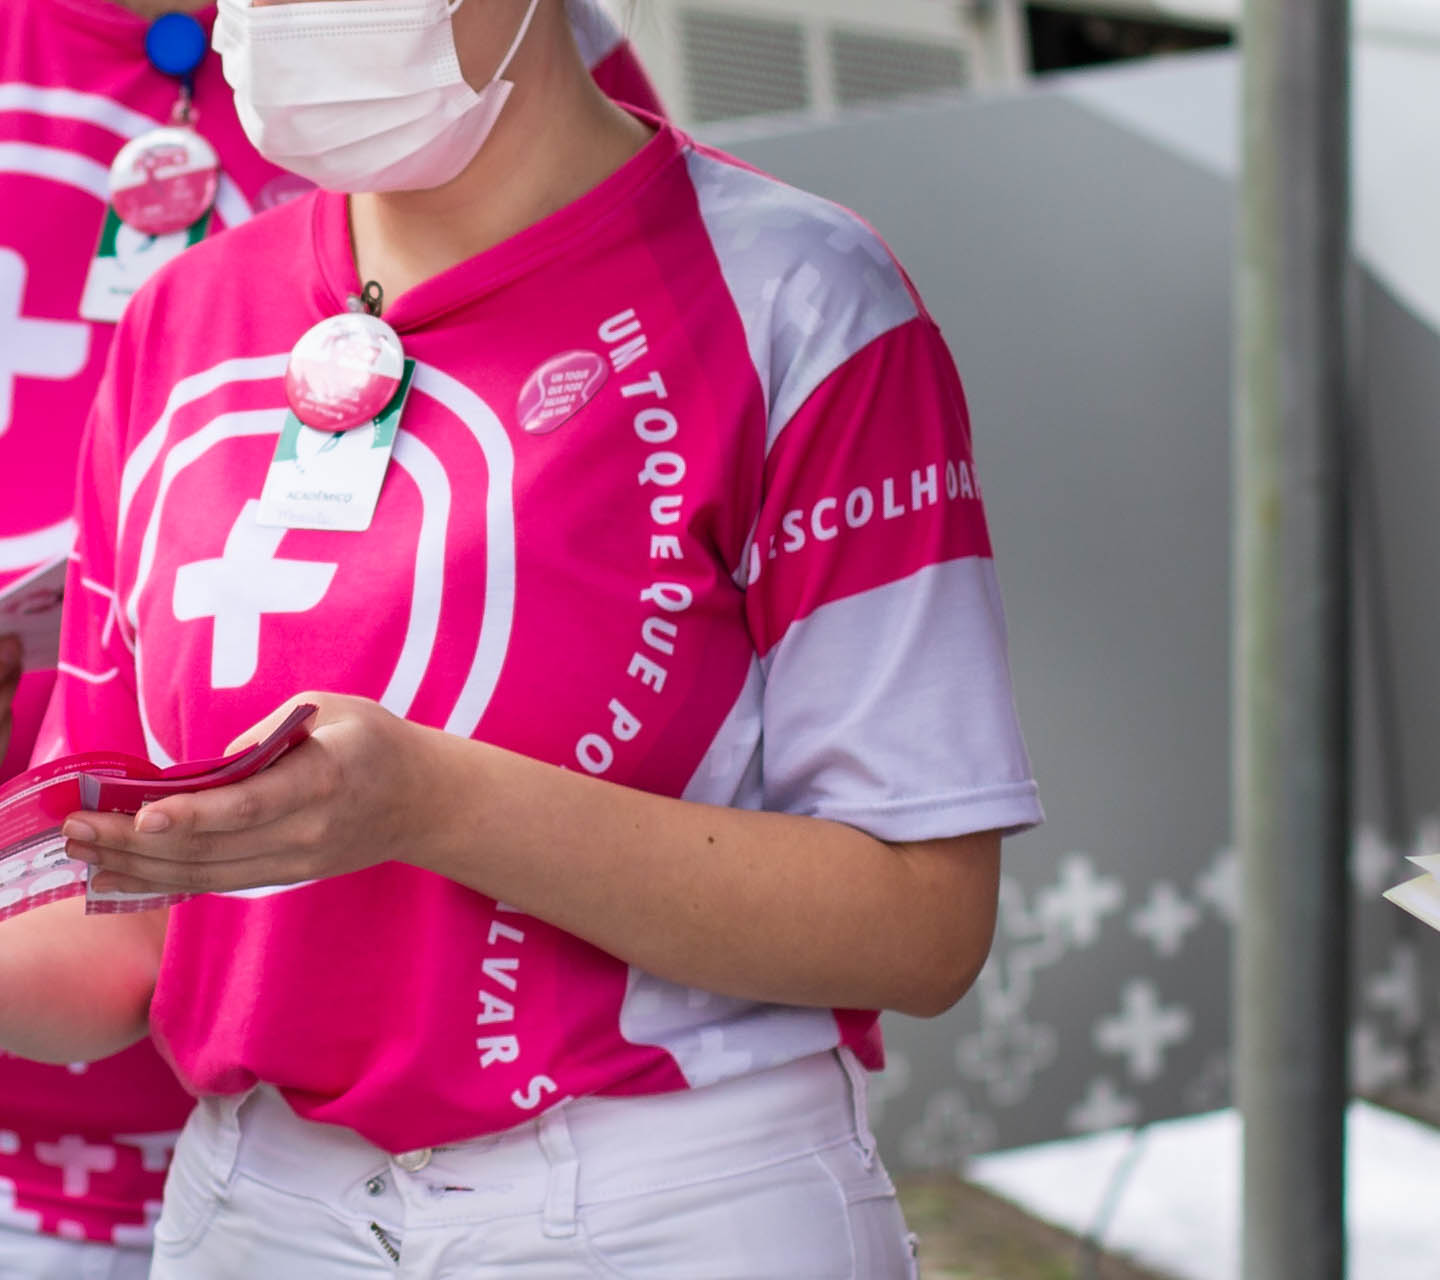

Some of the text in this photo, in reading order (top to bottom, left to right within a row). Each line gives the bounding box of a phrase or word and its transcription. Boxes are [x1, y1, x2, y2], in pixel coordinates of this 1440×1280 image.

[620, 371, 686, 560] TOQUE
[627, 581, 693, 693] QUE
[564, 697, 642, 775] PO
